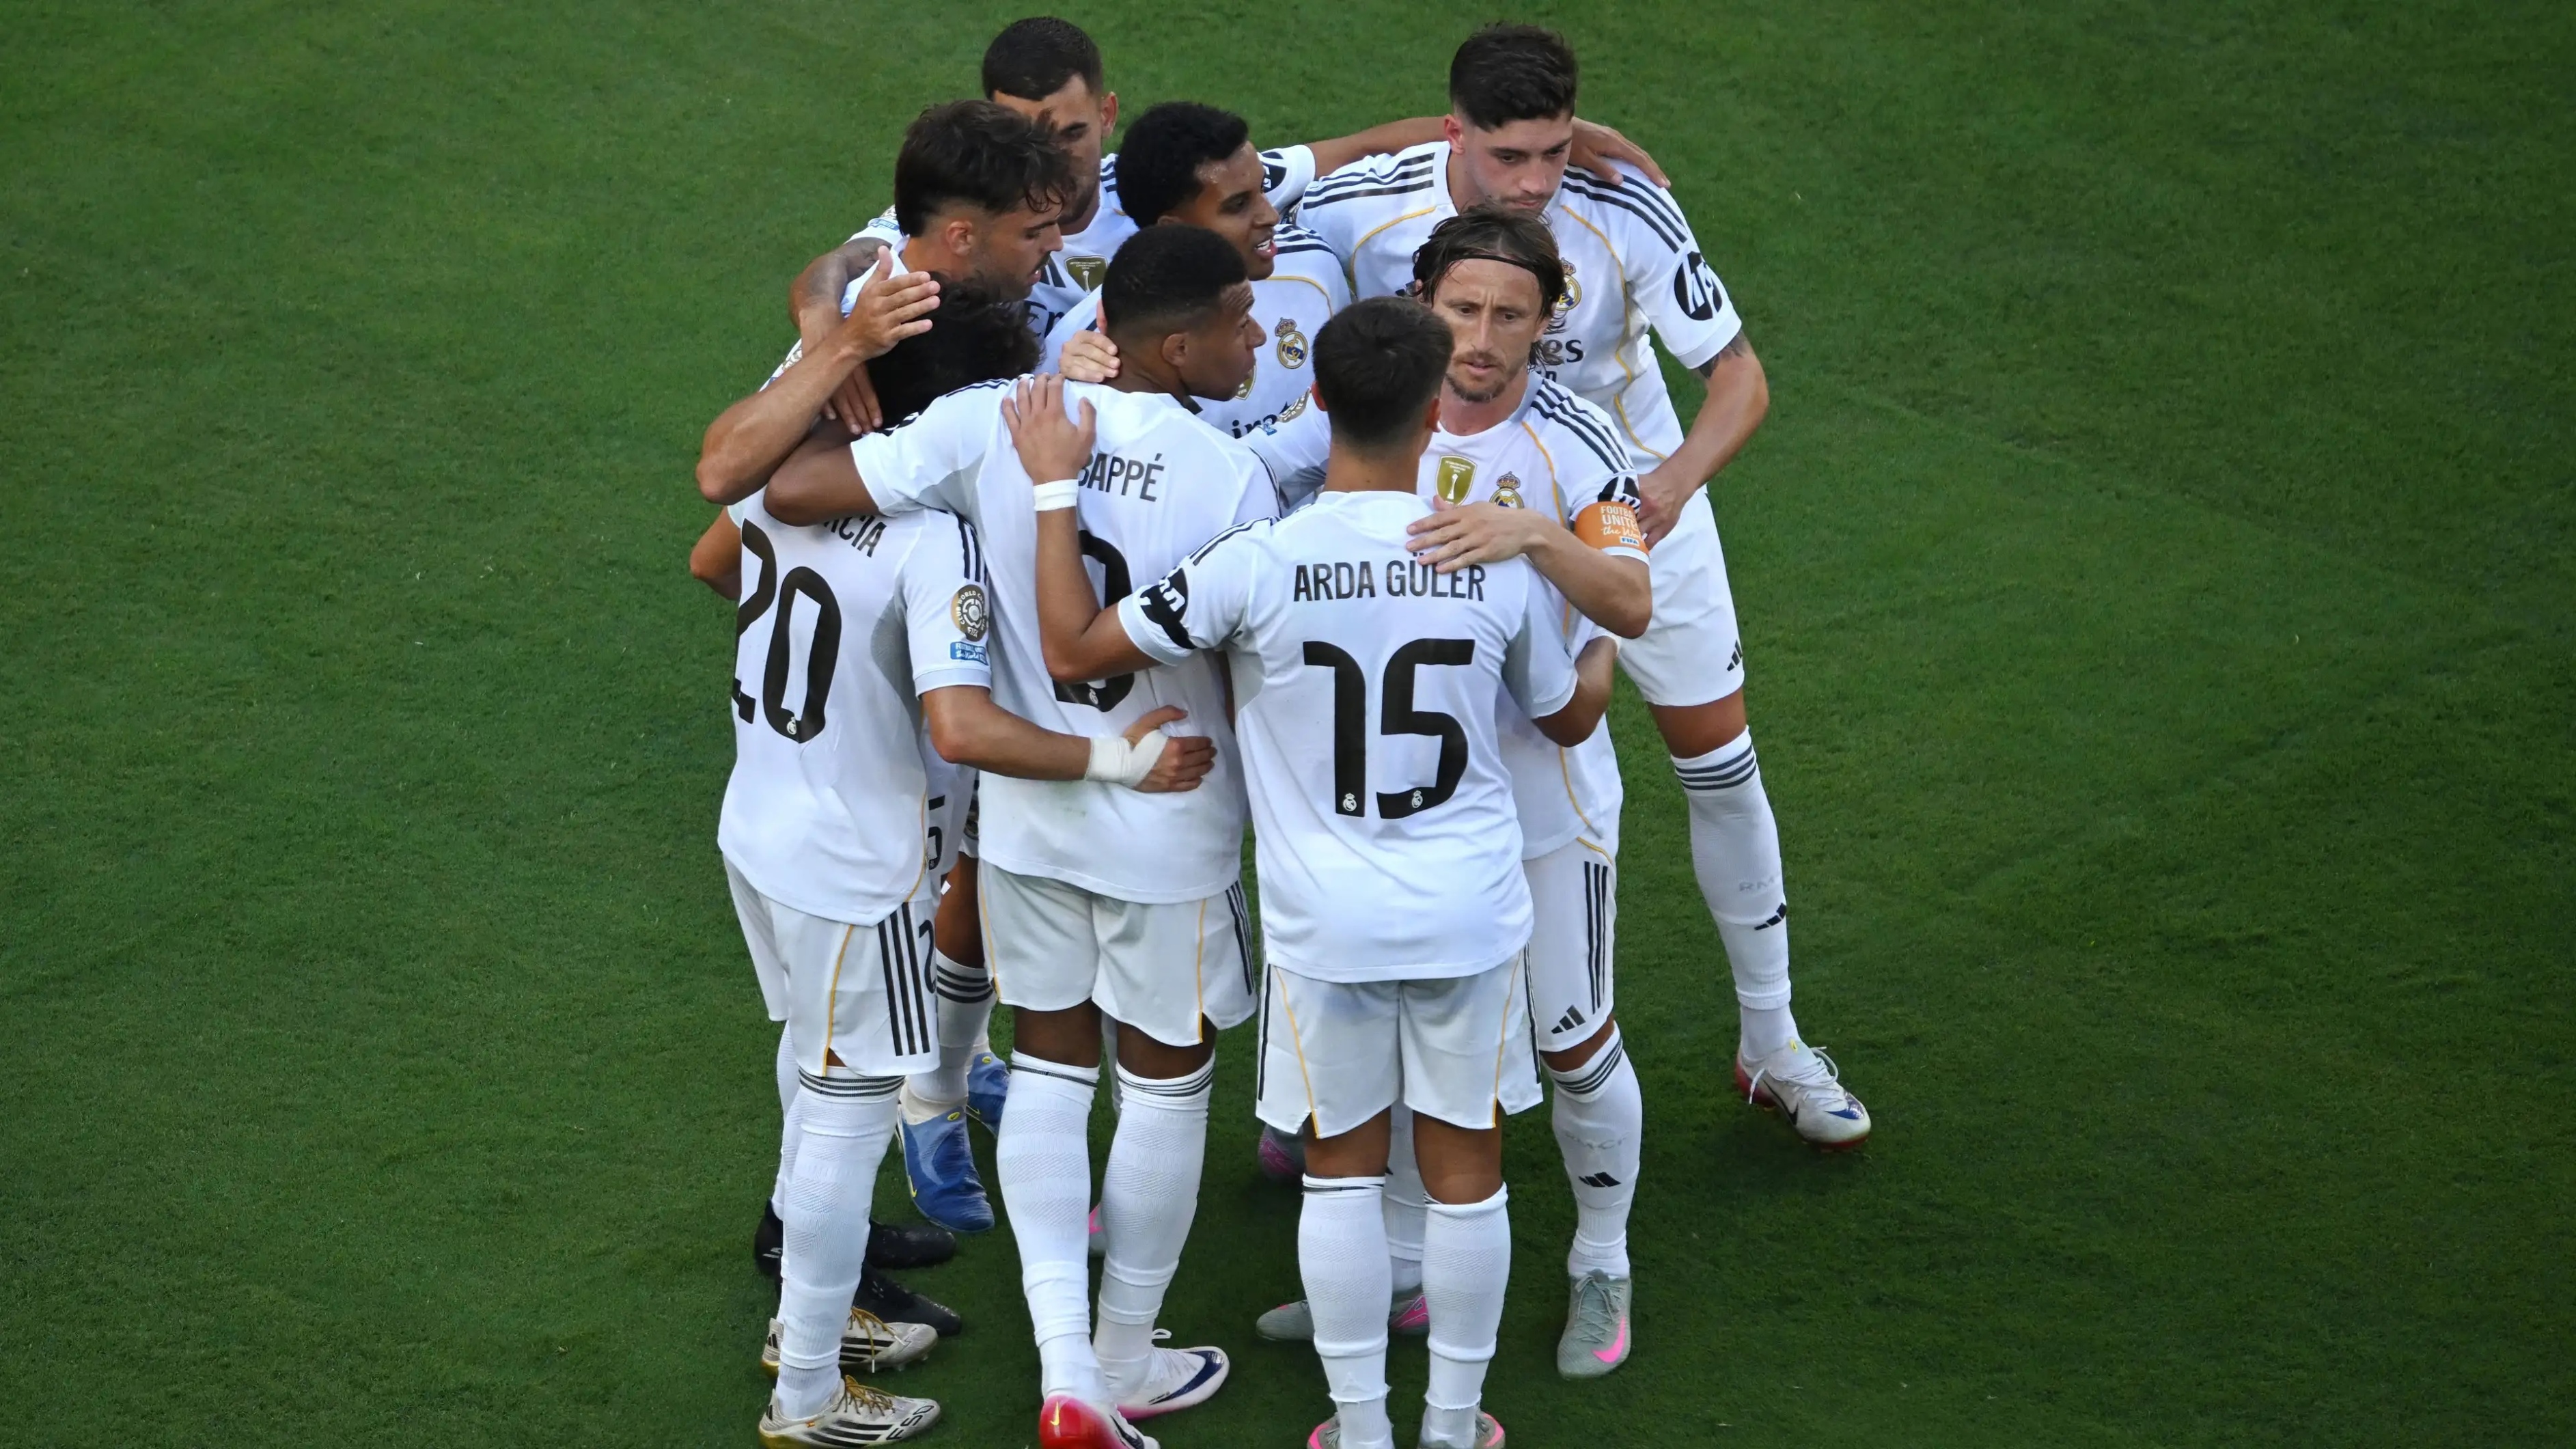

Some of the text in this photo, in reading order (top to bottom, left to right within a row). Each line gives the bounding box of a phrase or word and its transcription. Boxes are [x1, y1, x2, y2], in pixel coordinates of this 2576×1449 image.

[1078, 452, 1165, 502] BAPPÉ
[1601, 506, 1635, 519] FOOTBA
[1293, 552, 1486, 602] ARDA GÜLER
[1303, 638, 1475, 819] 15
[885, 1405, 934, 1441] F50
